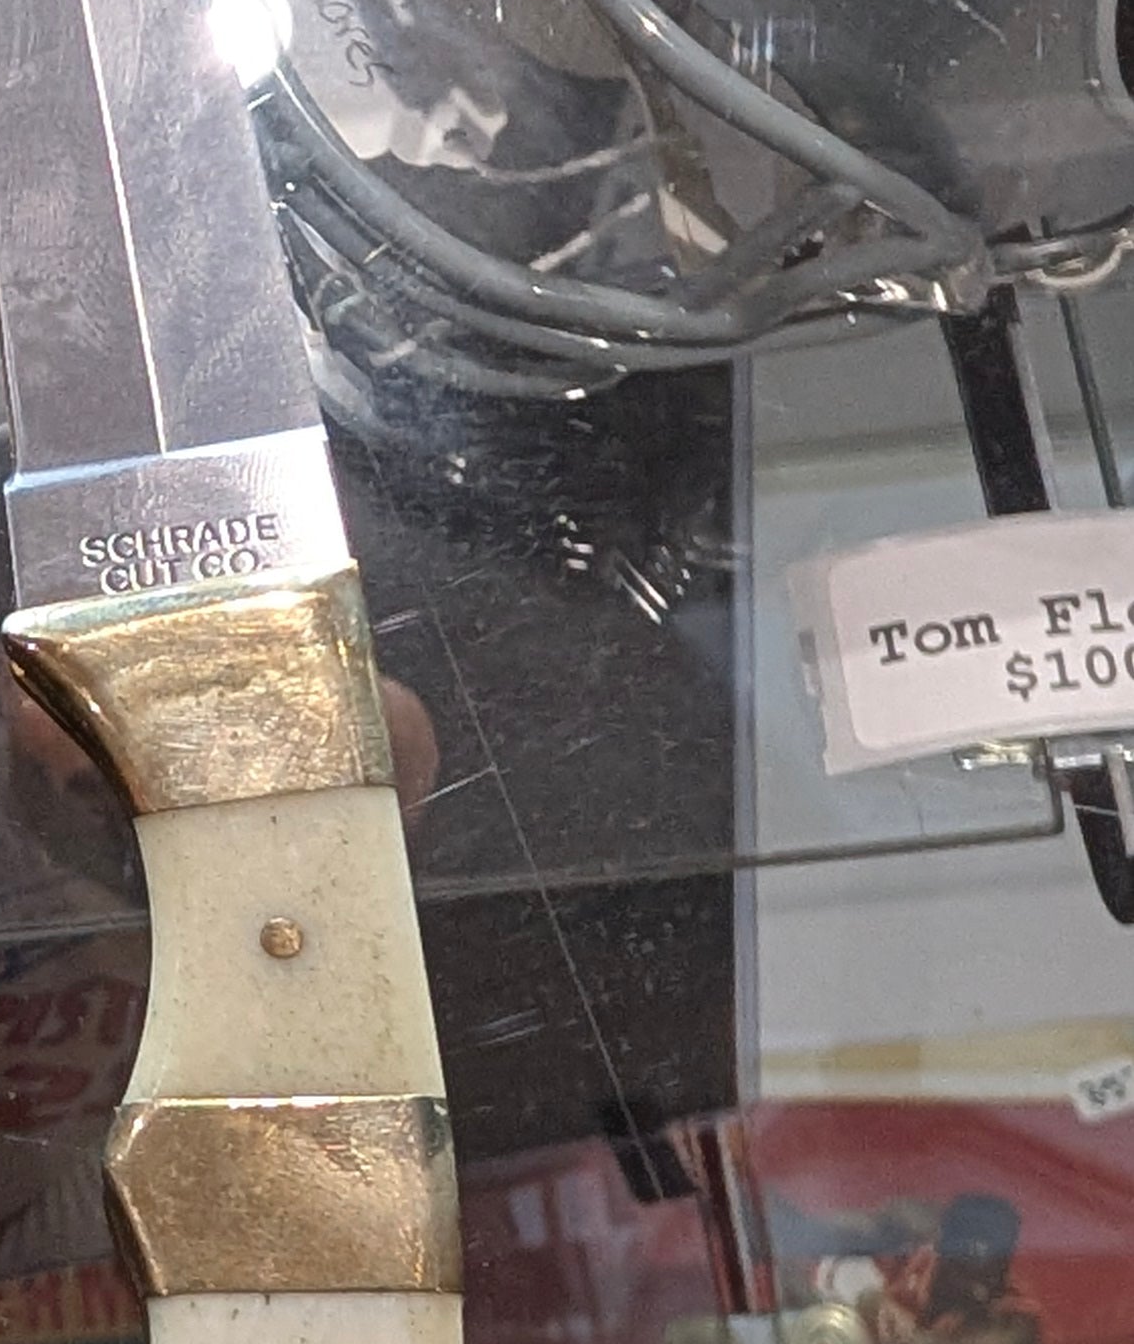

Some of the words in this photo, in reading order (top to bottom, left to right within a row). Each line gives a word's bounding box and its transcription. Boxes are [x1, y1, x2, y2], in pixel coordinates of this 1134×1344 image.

[79, 512, 280, 567] SCHRADE
[100, 557, 182, 595] CUT
[193, 548, 272, 582] CO.
[868, 612, 1002, 666] Tom
[1038, 588, 1134, 637] Fl
